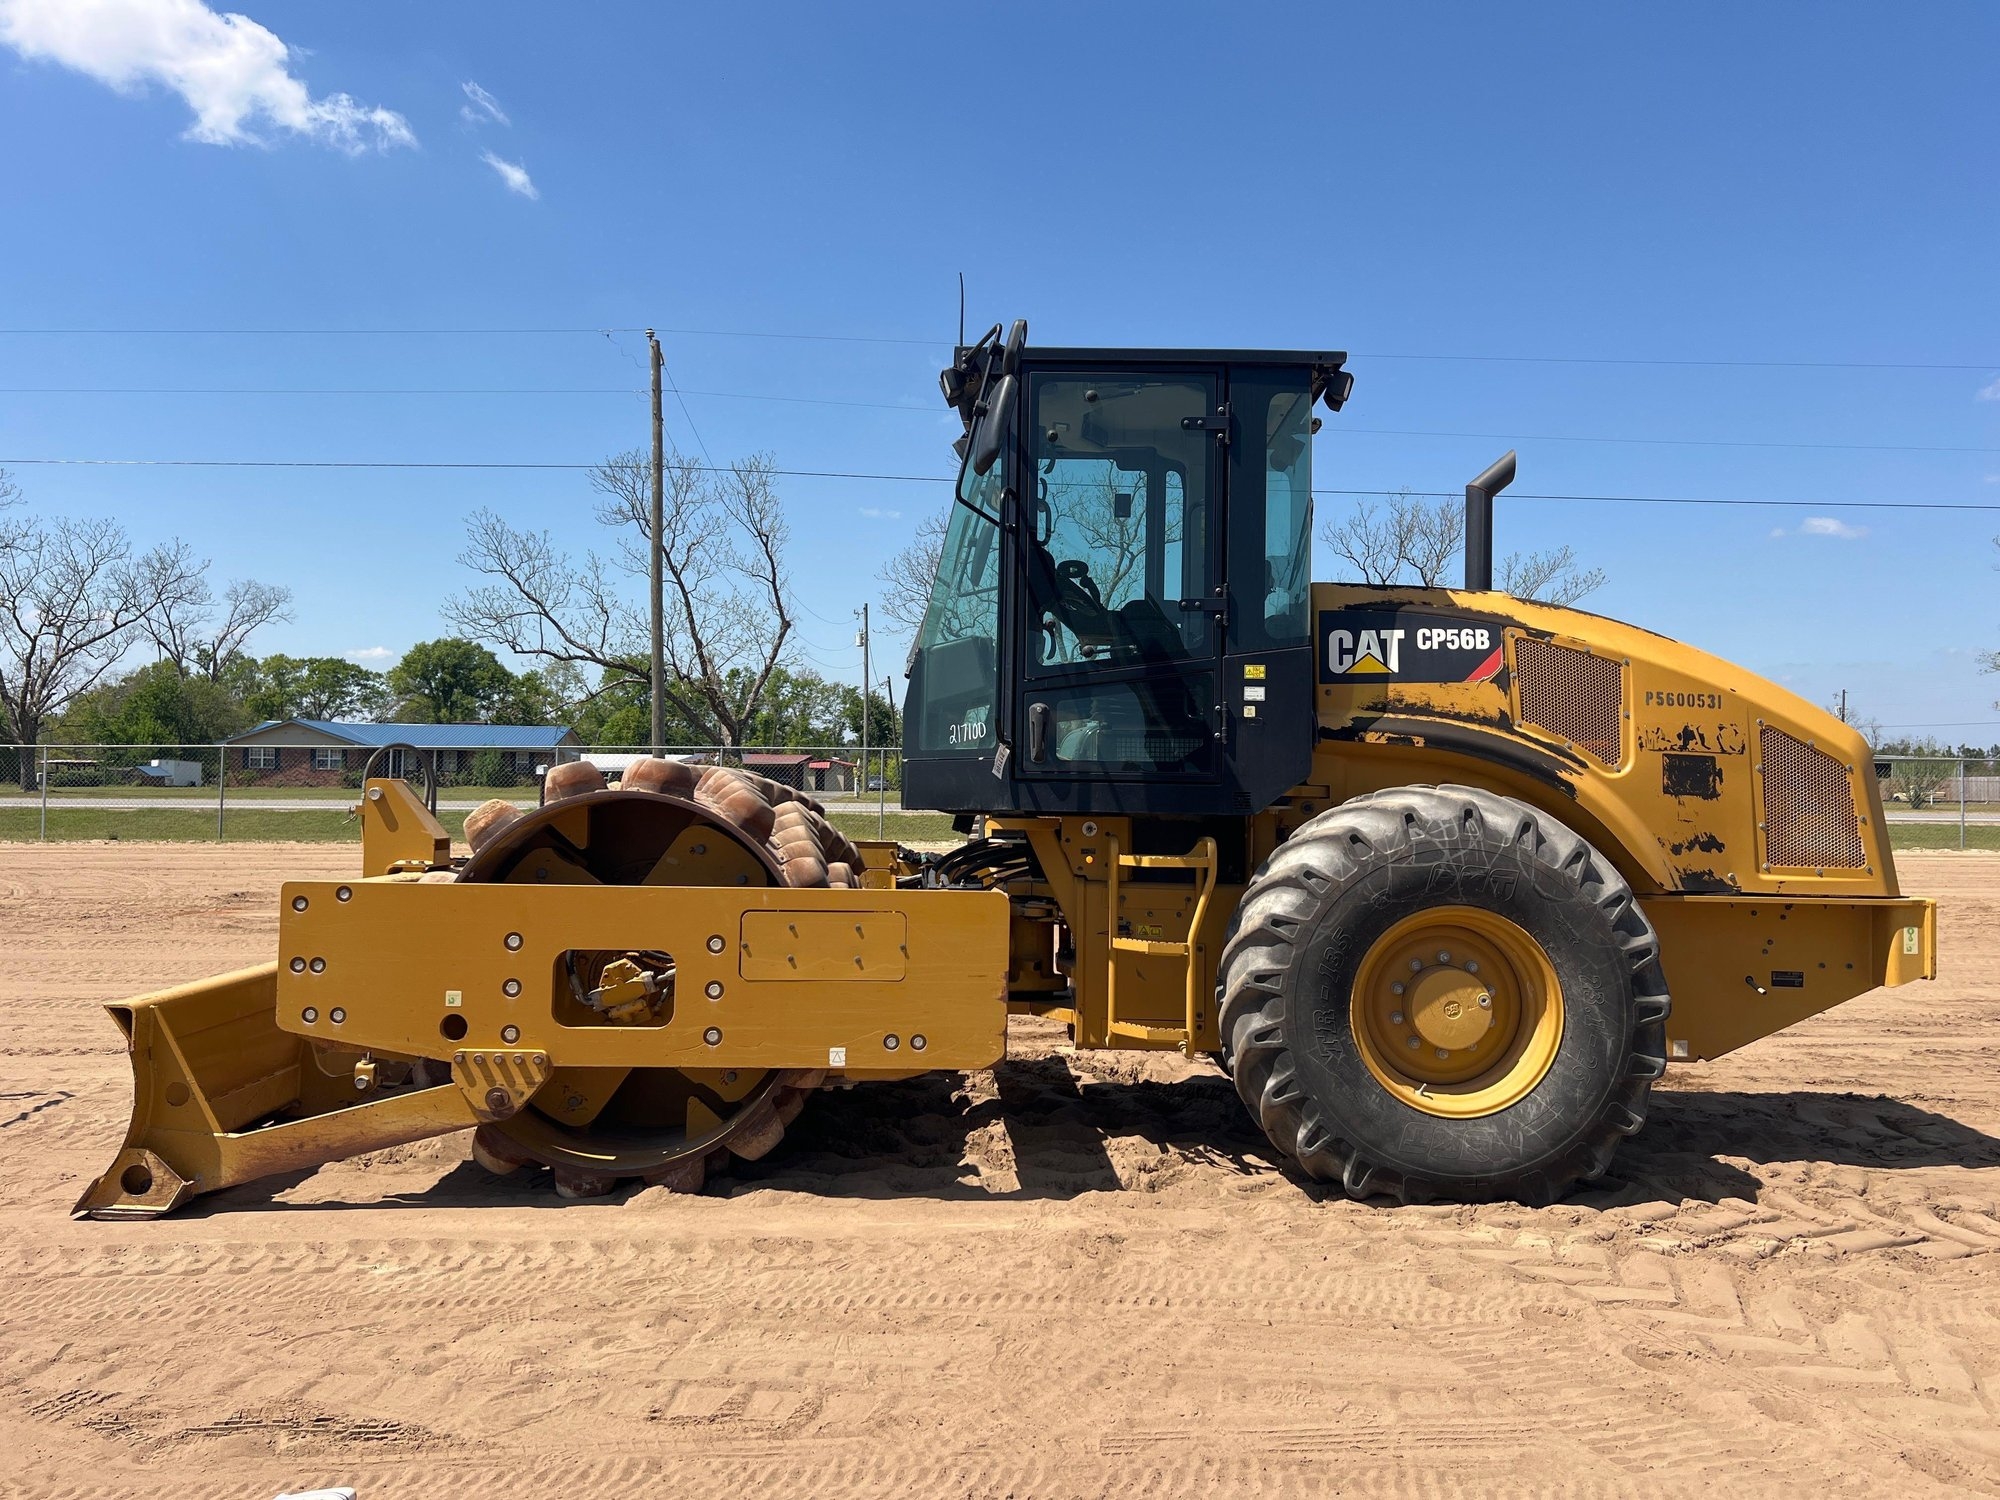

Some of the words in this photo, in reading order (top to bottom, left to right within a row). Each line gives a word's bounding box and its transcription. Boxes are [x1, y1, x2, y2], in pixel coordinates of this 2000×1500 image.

[1416, 628, 1491, 650] CP56B
[1328, 629, 1405, 674] CAT
[949, 721, 987, 744] 217100
